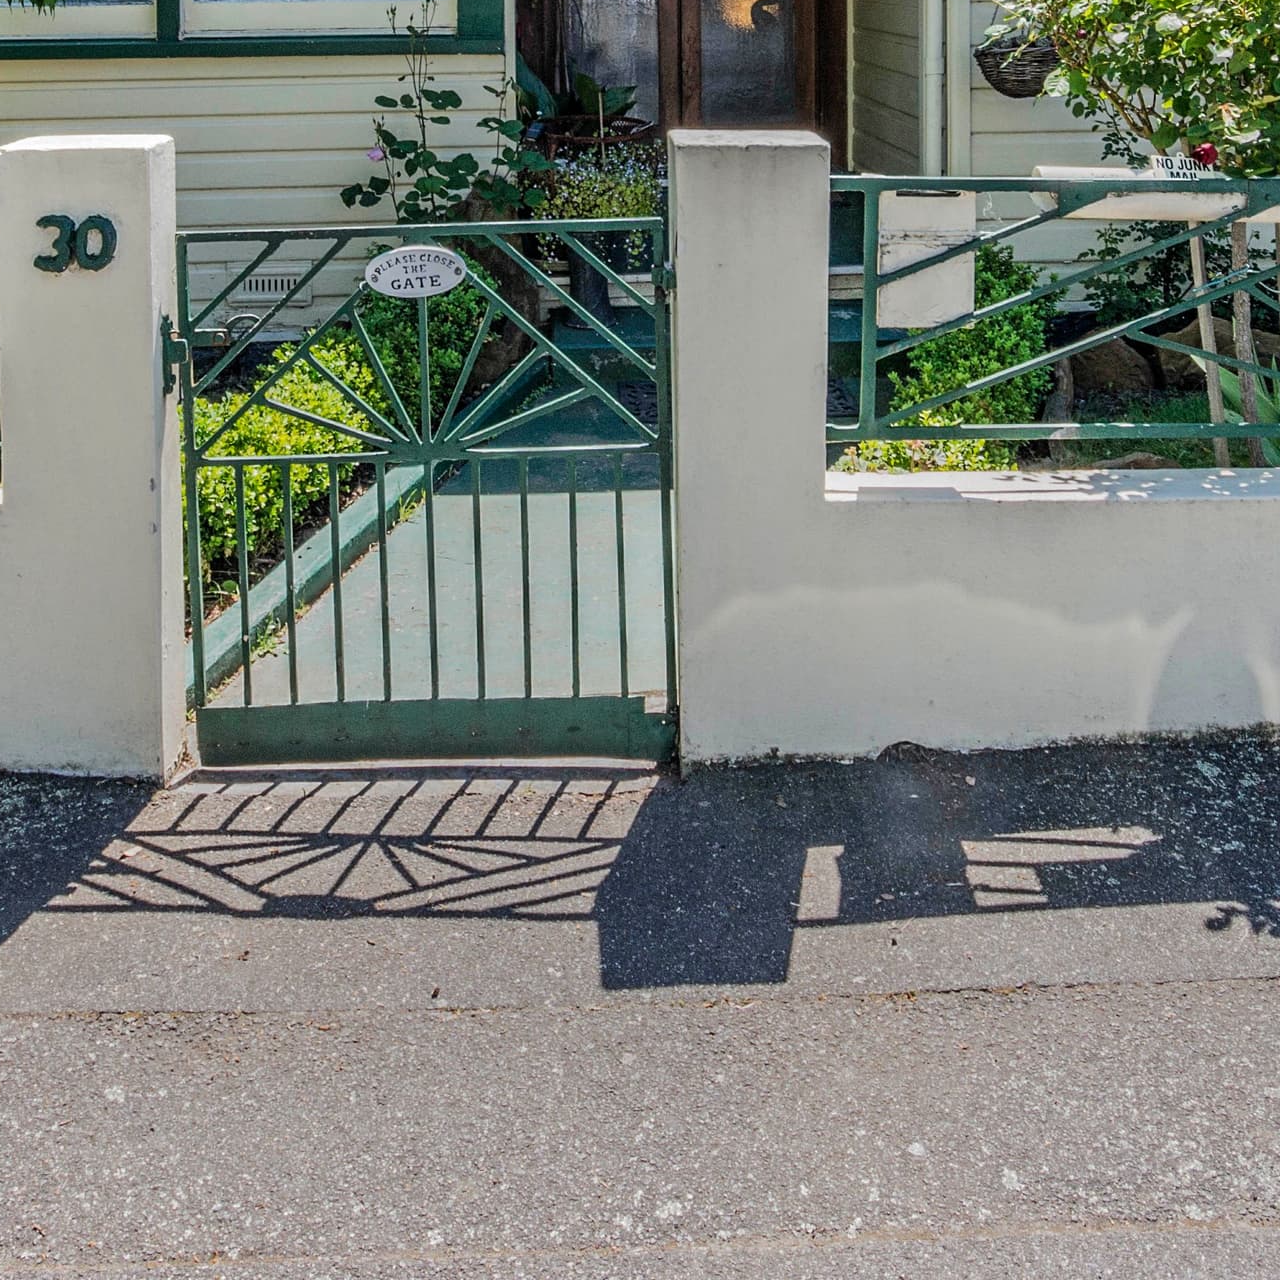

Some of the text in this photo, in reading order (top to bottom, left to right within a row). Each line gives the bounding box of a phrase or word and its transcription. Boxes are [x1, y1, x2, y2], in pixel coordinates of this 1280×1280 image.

[1156, 158, 1211, 172] NO JUNK
[33, 214, 118, 273] 30
[374, 253, 456, 276] PLEASE CLOSE
[402, 263, 427, 275] THE
[390, 274, 442, 291] GATE
